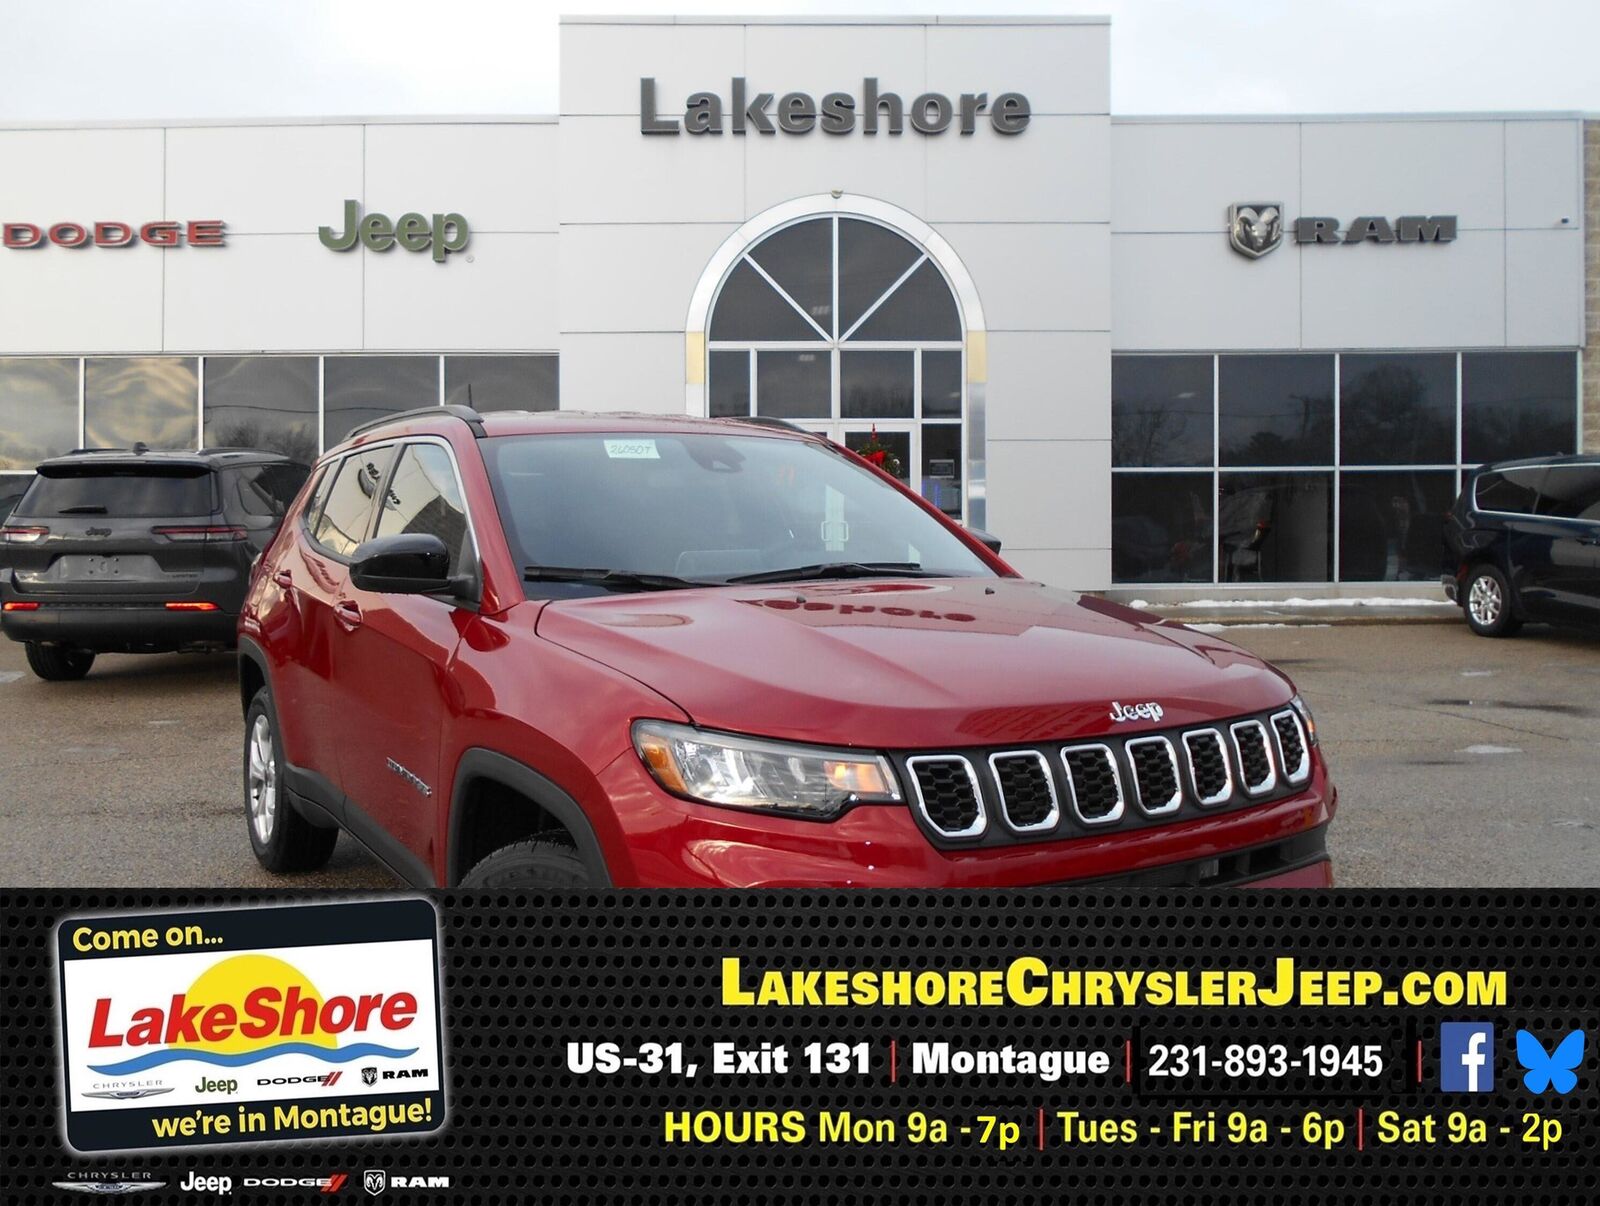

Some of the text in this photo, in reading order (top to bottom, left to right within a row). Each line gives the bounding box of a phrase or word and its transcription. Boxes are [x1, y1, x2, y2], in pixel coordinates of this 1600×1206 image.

[640, 77, 1031, 137] Lakeshore
[3, 220, 224, 248] DODGE
[318, 199, 470, 263] Jeep
[1295, 215, 1458, 245] RAM
[1109, 701, 1164, 722] Jeep
